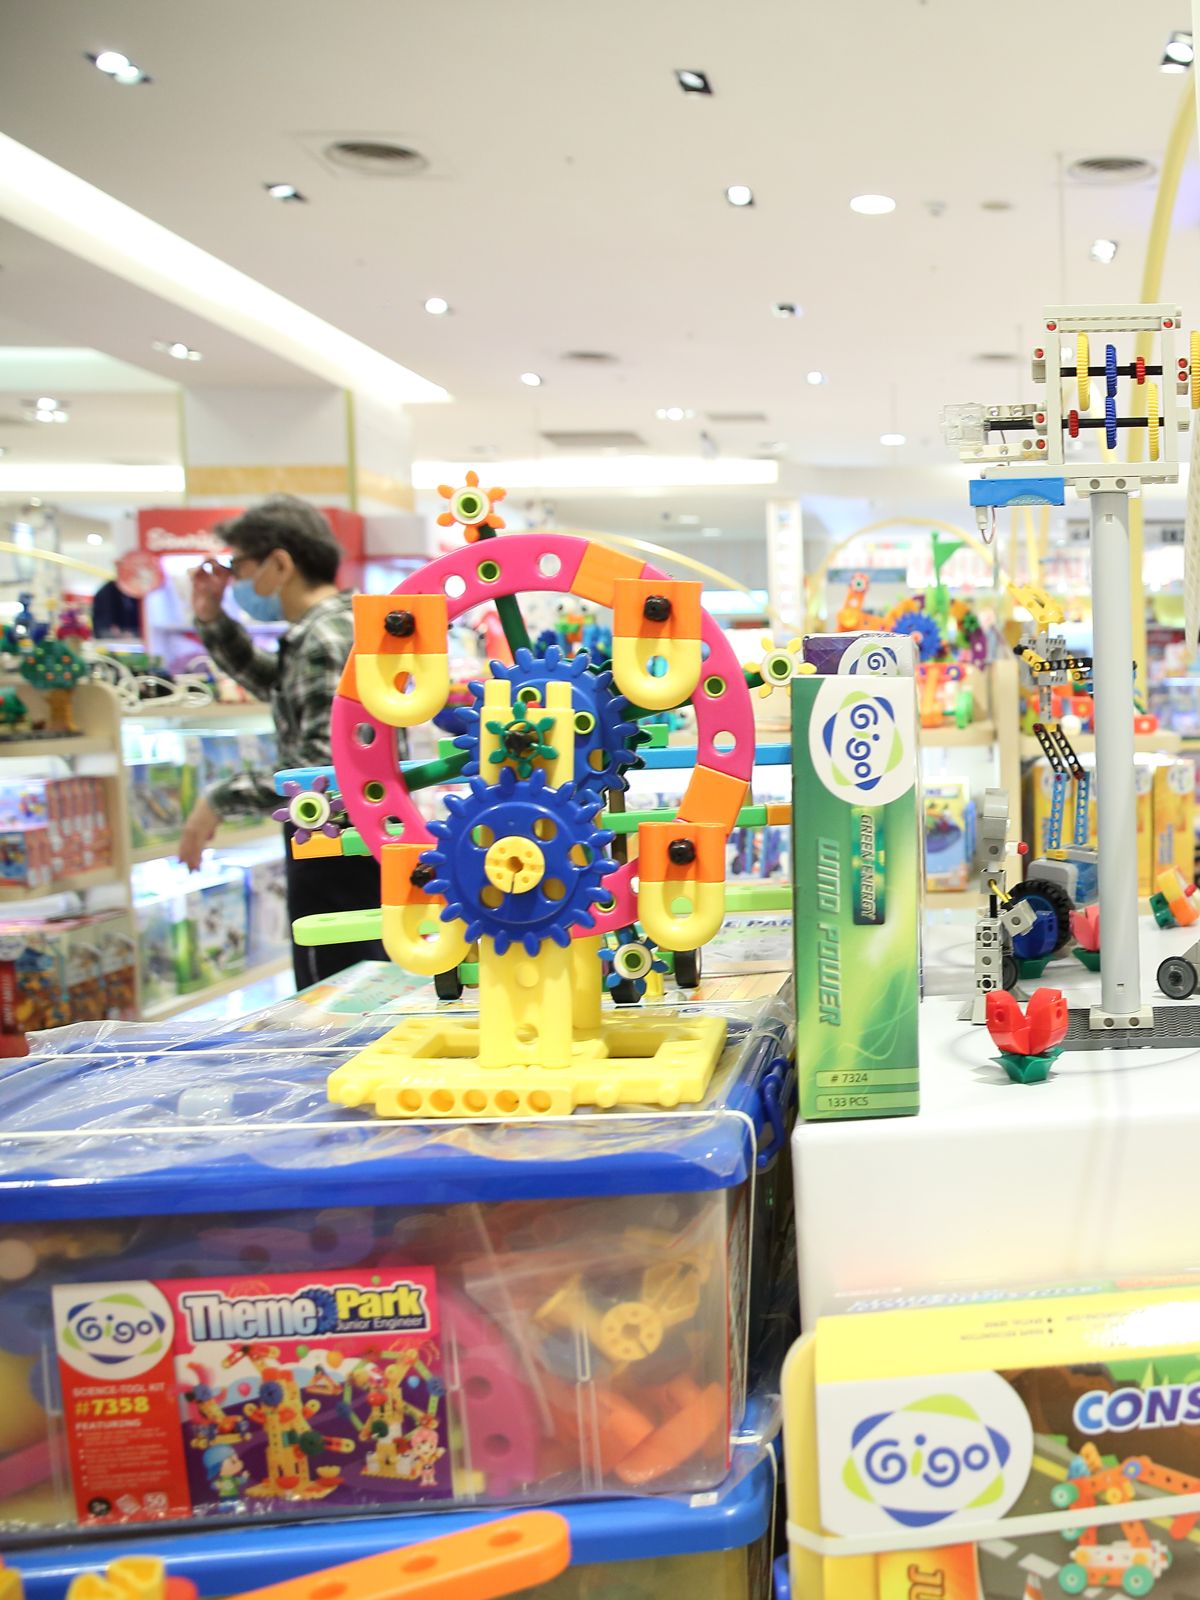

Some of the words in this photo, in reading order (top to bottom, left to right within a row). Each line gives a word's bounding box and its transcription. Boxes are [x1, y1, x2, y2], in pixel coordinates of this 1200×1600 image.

[845, 704, 880, 778] Gigo
[860, 814, 874, 861] GREEN
[860, 864, 876, 920] ENERGY
[817, 923, 841, 1026] POWER
[842, 1073, 868, 1084] 7324
[828, 1097, 847, 1108] 133
[849, 1097, 868, 1107] PCS
[76, 1314, 153, 1344] Gigo
[183, 1293, 318, 1342] Theme
[335, 1284, 423, 1320] Park
[337, 1319, 371, 1332] Junior
[373, 1316, 424, 1331] Engineer
[74, 1396, 150, 1416] #7358
[865, 1433, 990, 1488] Gigo
